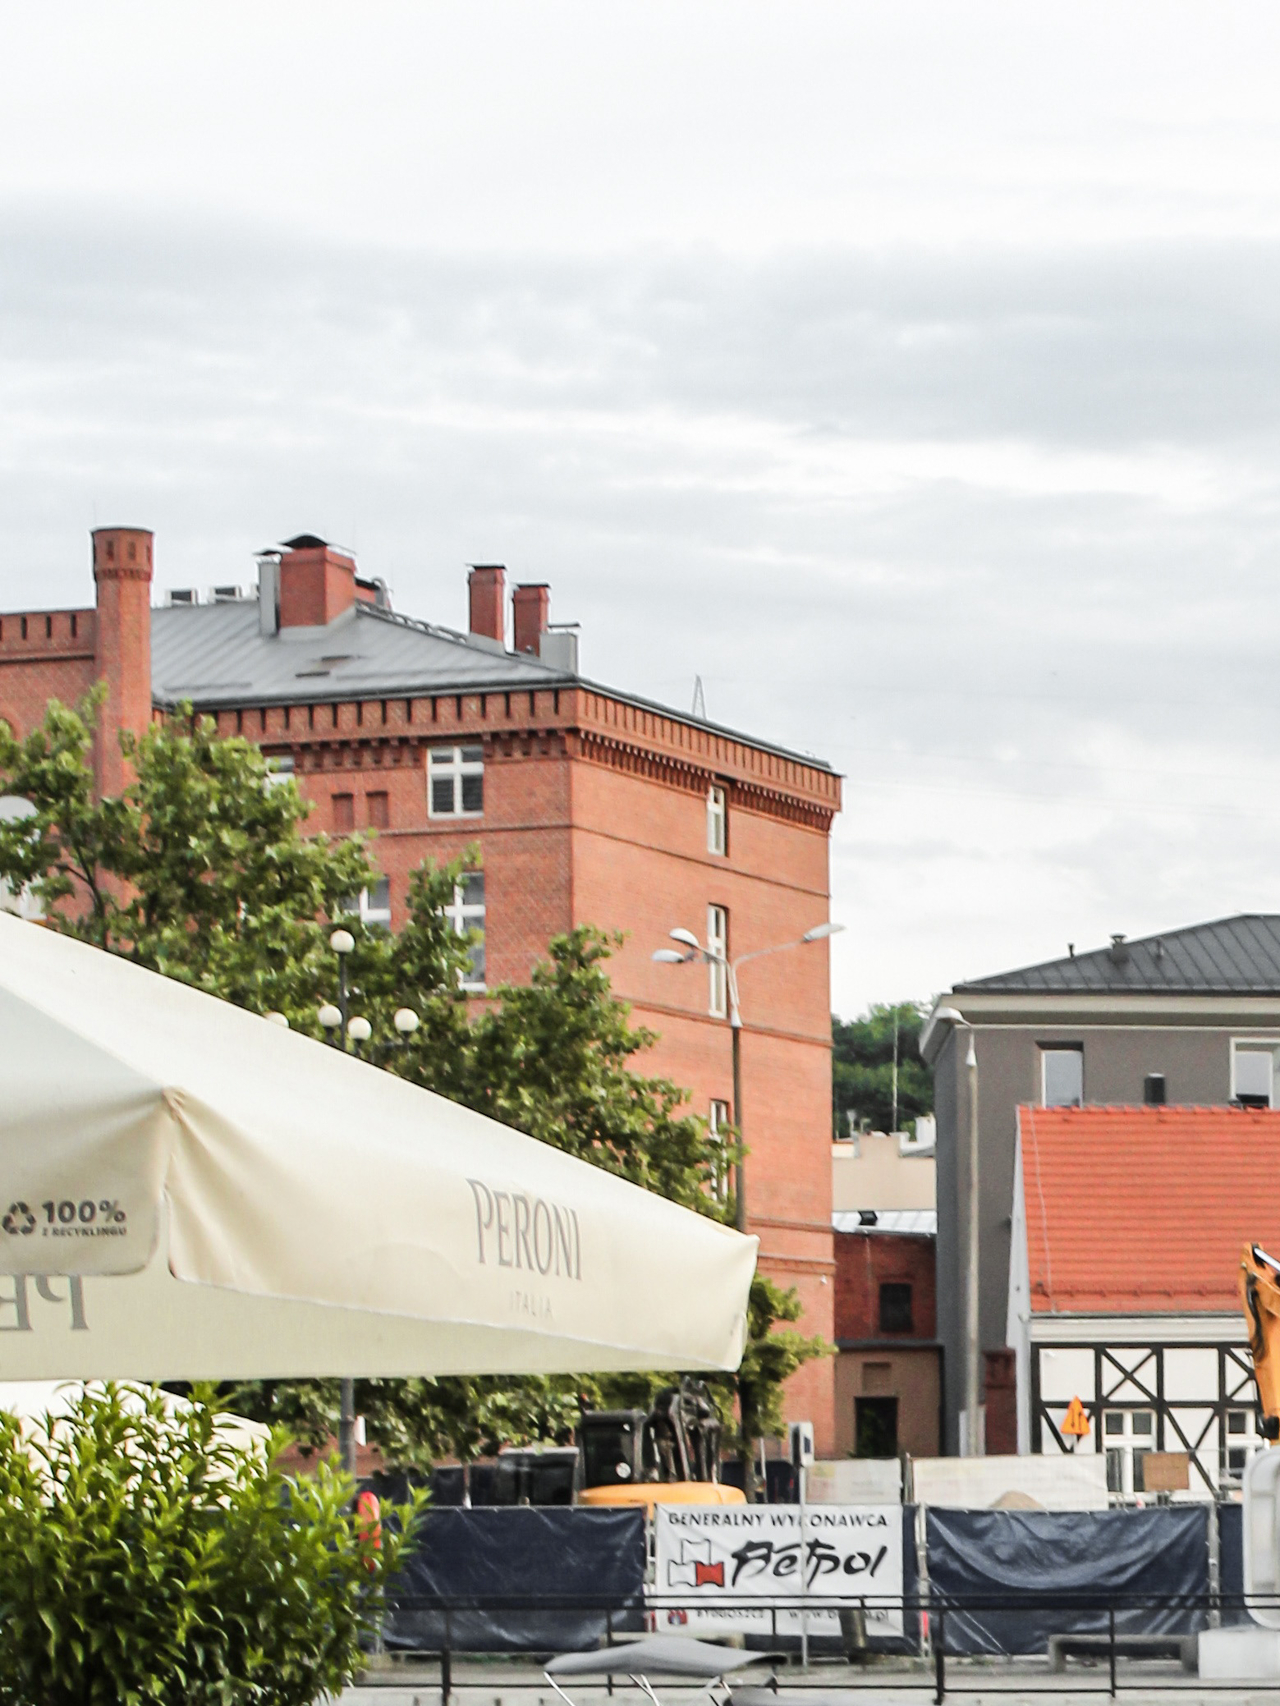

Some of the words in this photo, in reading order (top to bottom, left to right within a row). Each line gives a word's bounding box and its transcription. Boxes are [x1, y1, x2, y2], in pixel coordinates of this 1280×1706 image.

[42, 1200, 126, 1223] 100%
[465, 1177, 583, 1281] PERONI
[668, 1512, 764, 1527] GENERALNY
